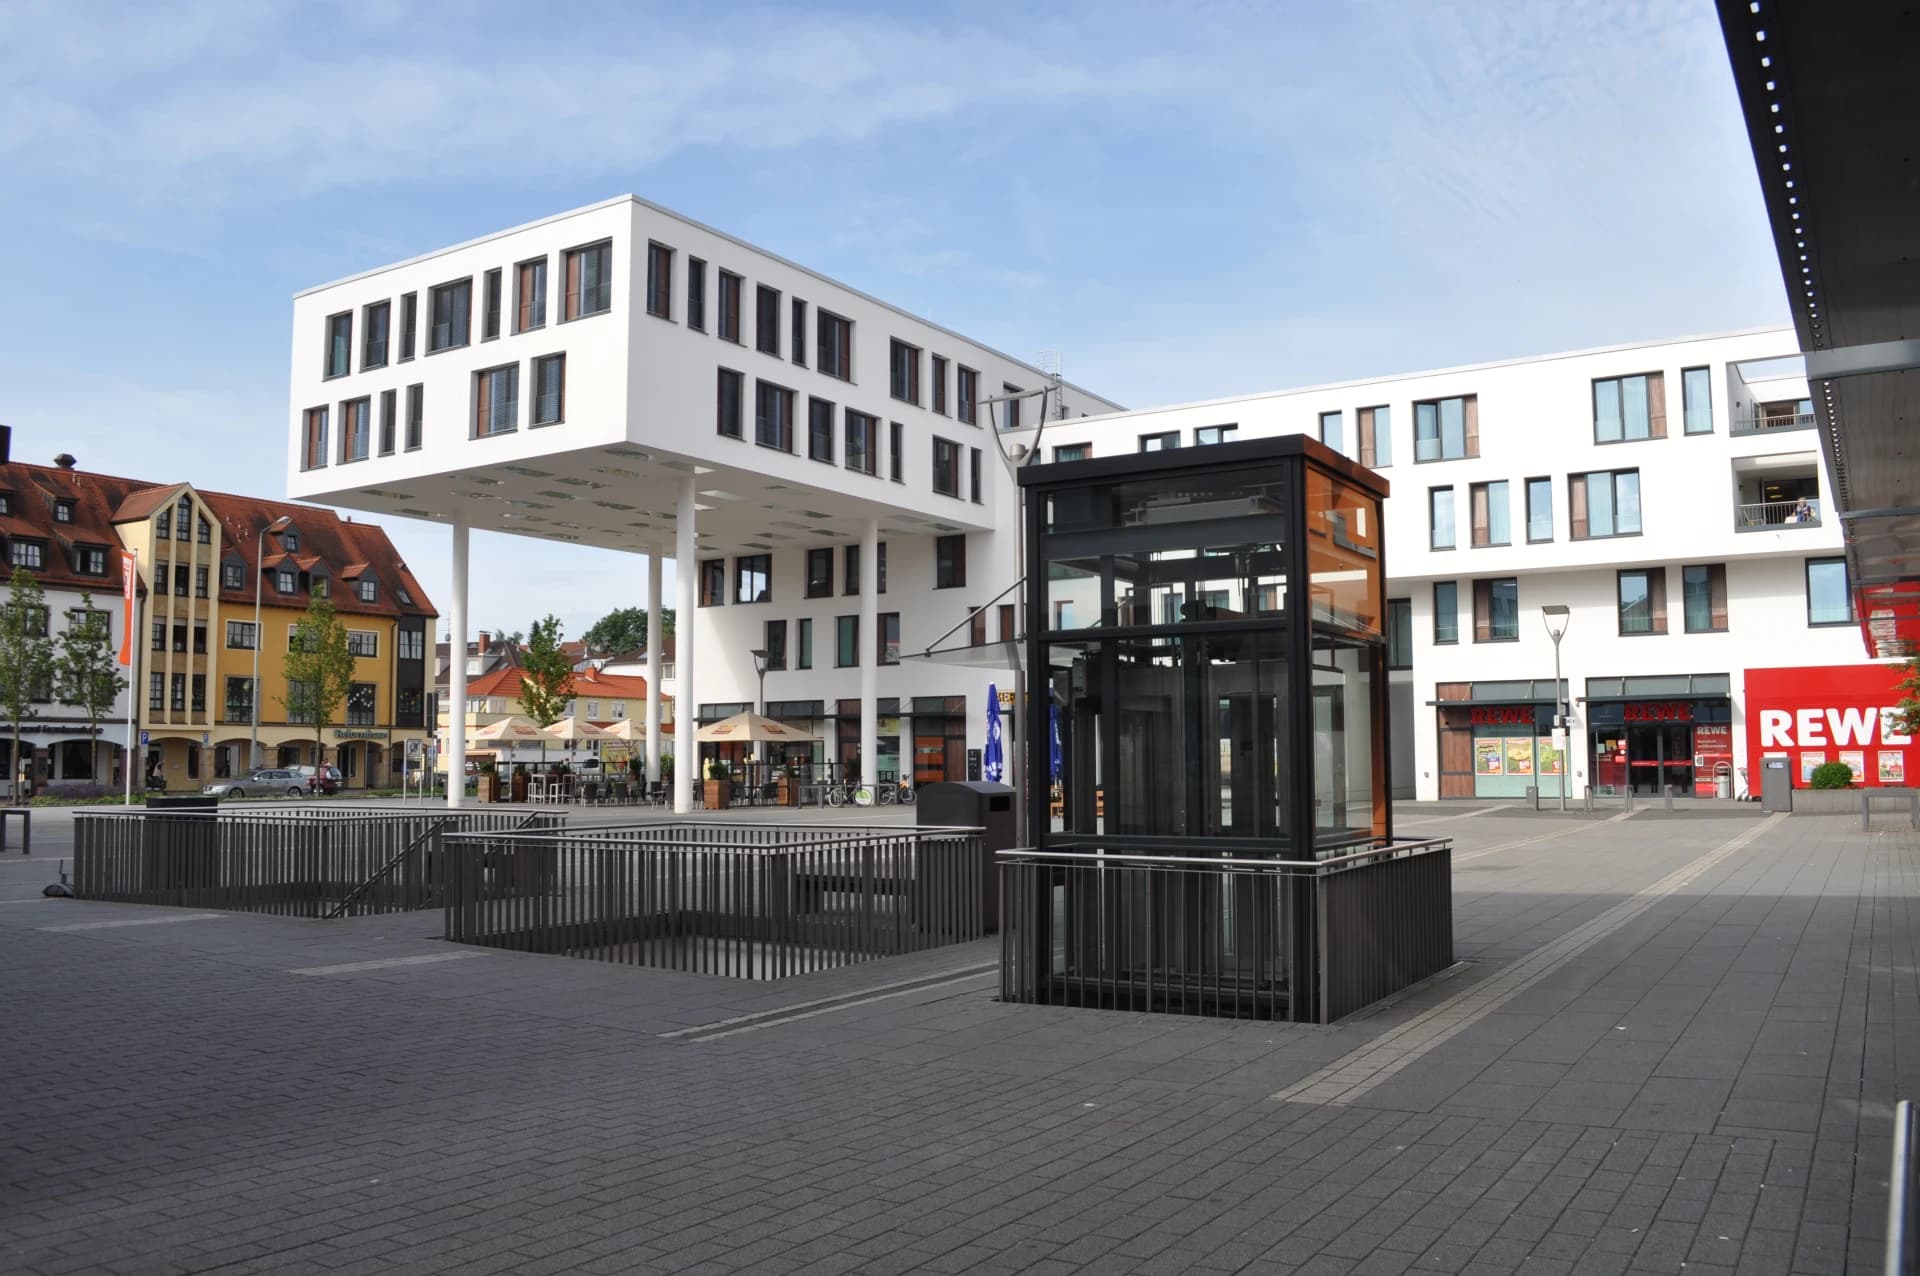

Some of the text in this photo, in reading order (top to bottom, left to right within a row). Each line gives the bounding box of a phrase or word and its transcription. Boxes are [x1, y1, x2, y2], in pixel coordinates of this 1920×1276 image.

[1471, 706, 1534, 724] REWE
[1624, 704, 1692, 721] REWE
[1697, 726, 1728, 735] REWE
[1760, 707, 1912, 747] REWE
